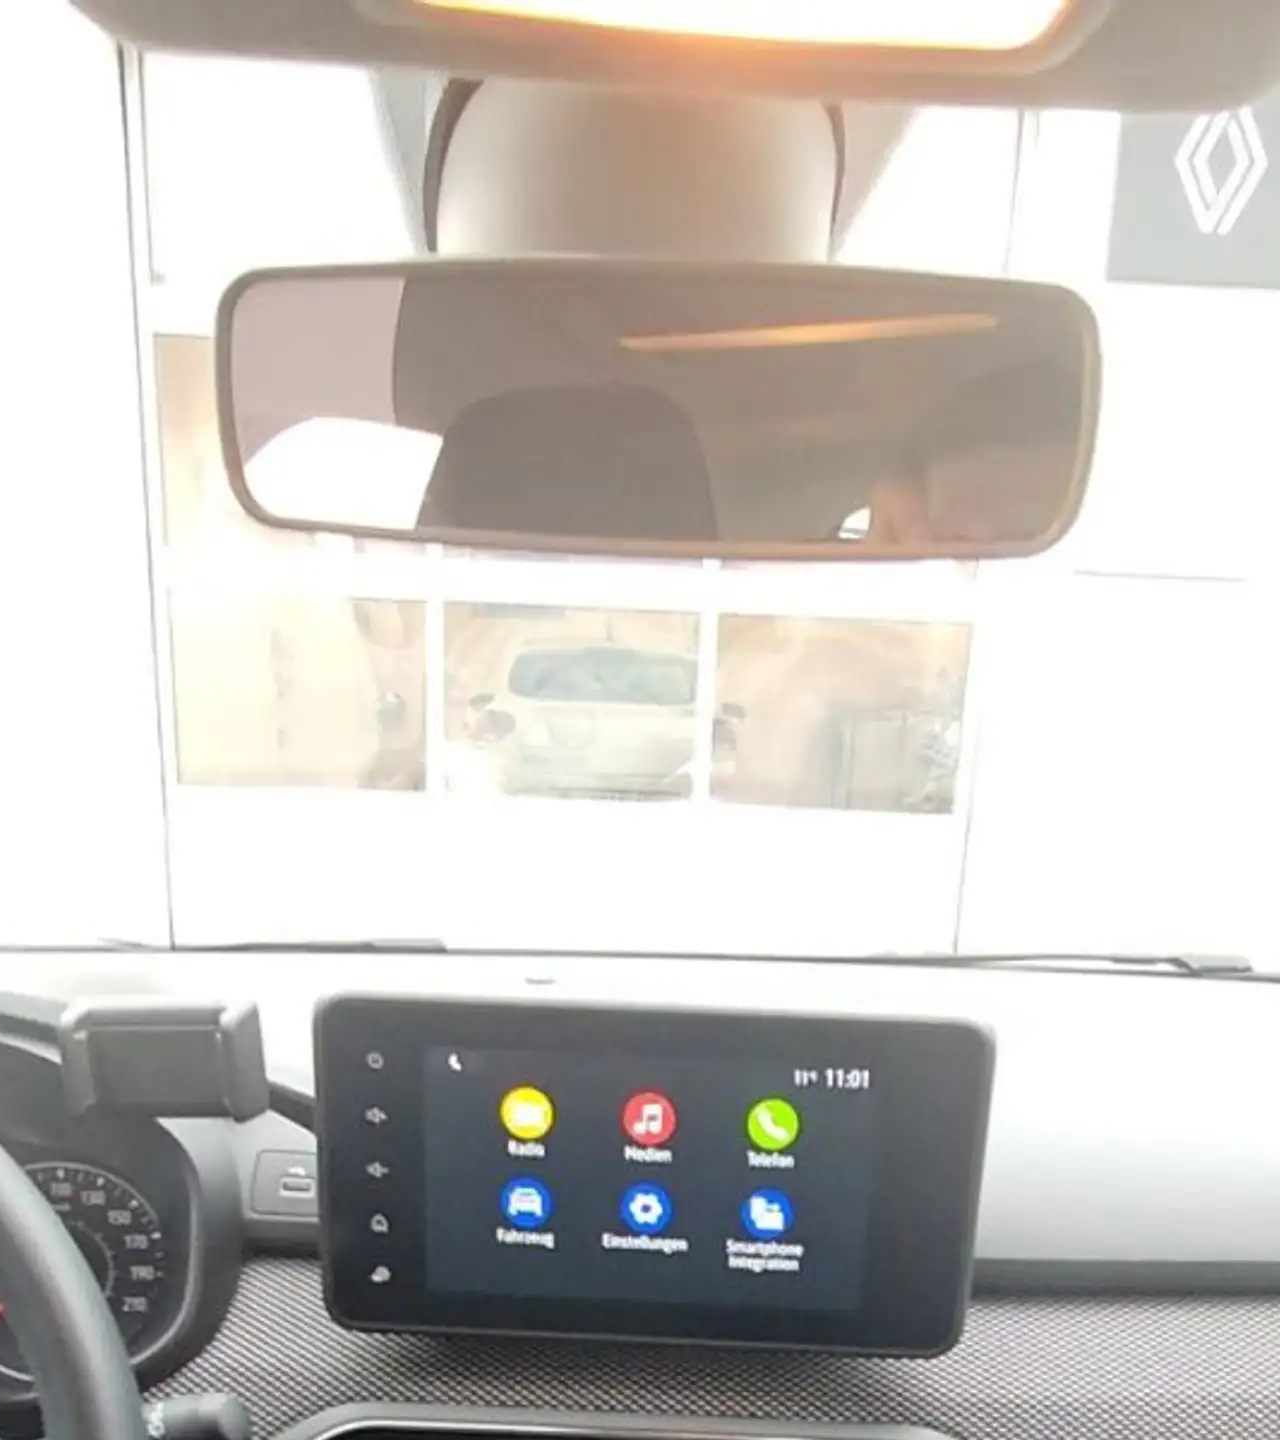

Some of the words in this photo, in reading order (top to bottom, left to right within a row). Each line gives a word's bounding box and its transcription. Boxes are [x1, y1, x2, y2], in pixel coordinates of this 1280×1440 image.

[825, 1066, 870, 1090] 11:01
[507, 1139, 546, 1158] Radio
[624, 1144, 673, 1163] Medien
[747, 1150, 795, 1170] Telefon
[495, 1226, 555, 1249] Fahrzeug
[601, 1232, 689, 1255] Einstellungen
[726, 1238, 805, 1257] Smartphone
[728, 1255, 800, 1273] Integration
